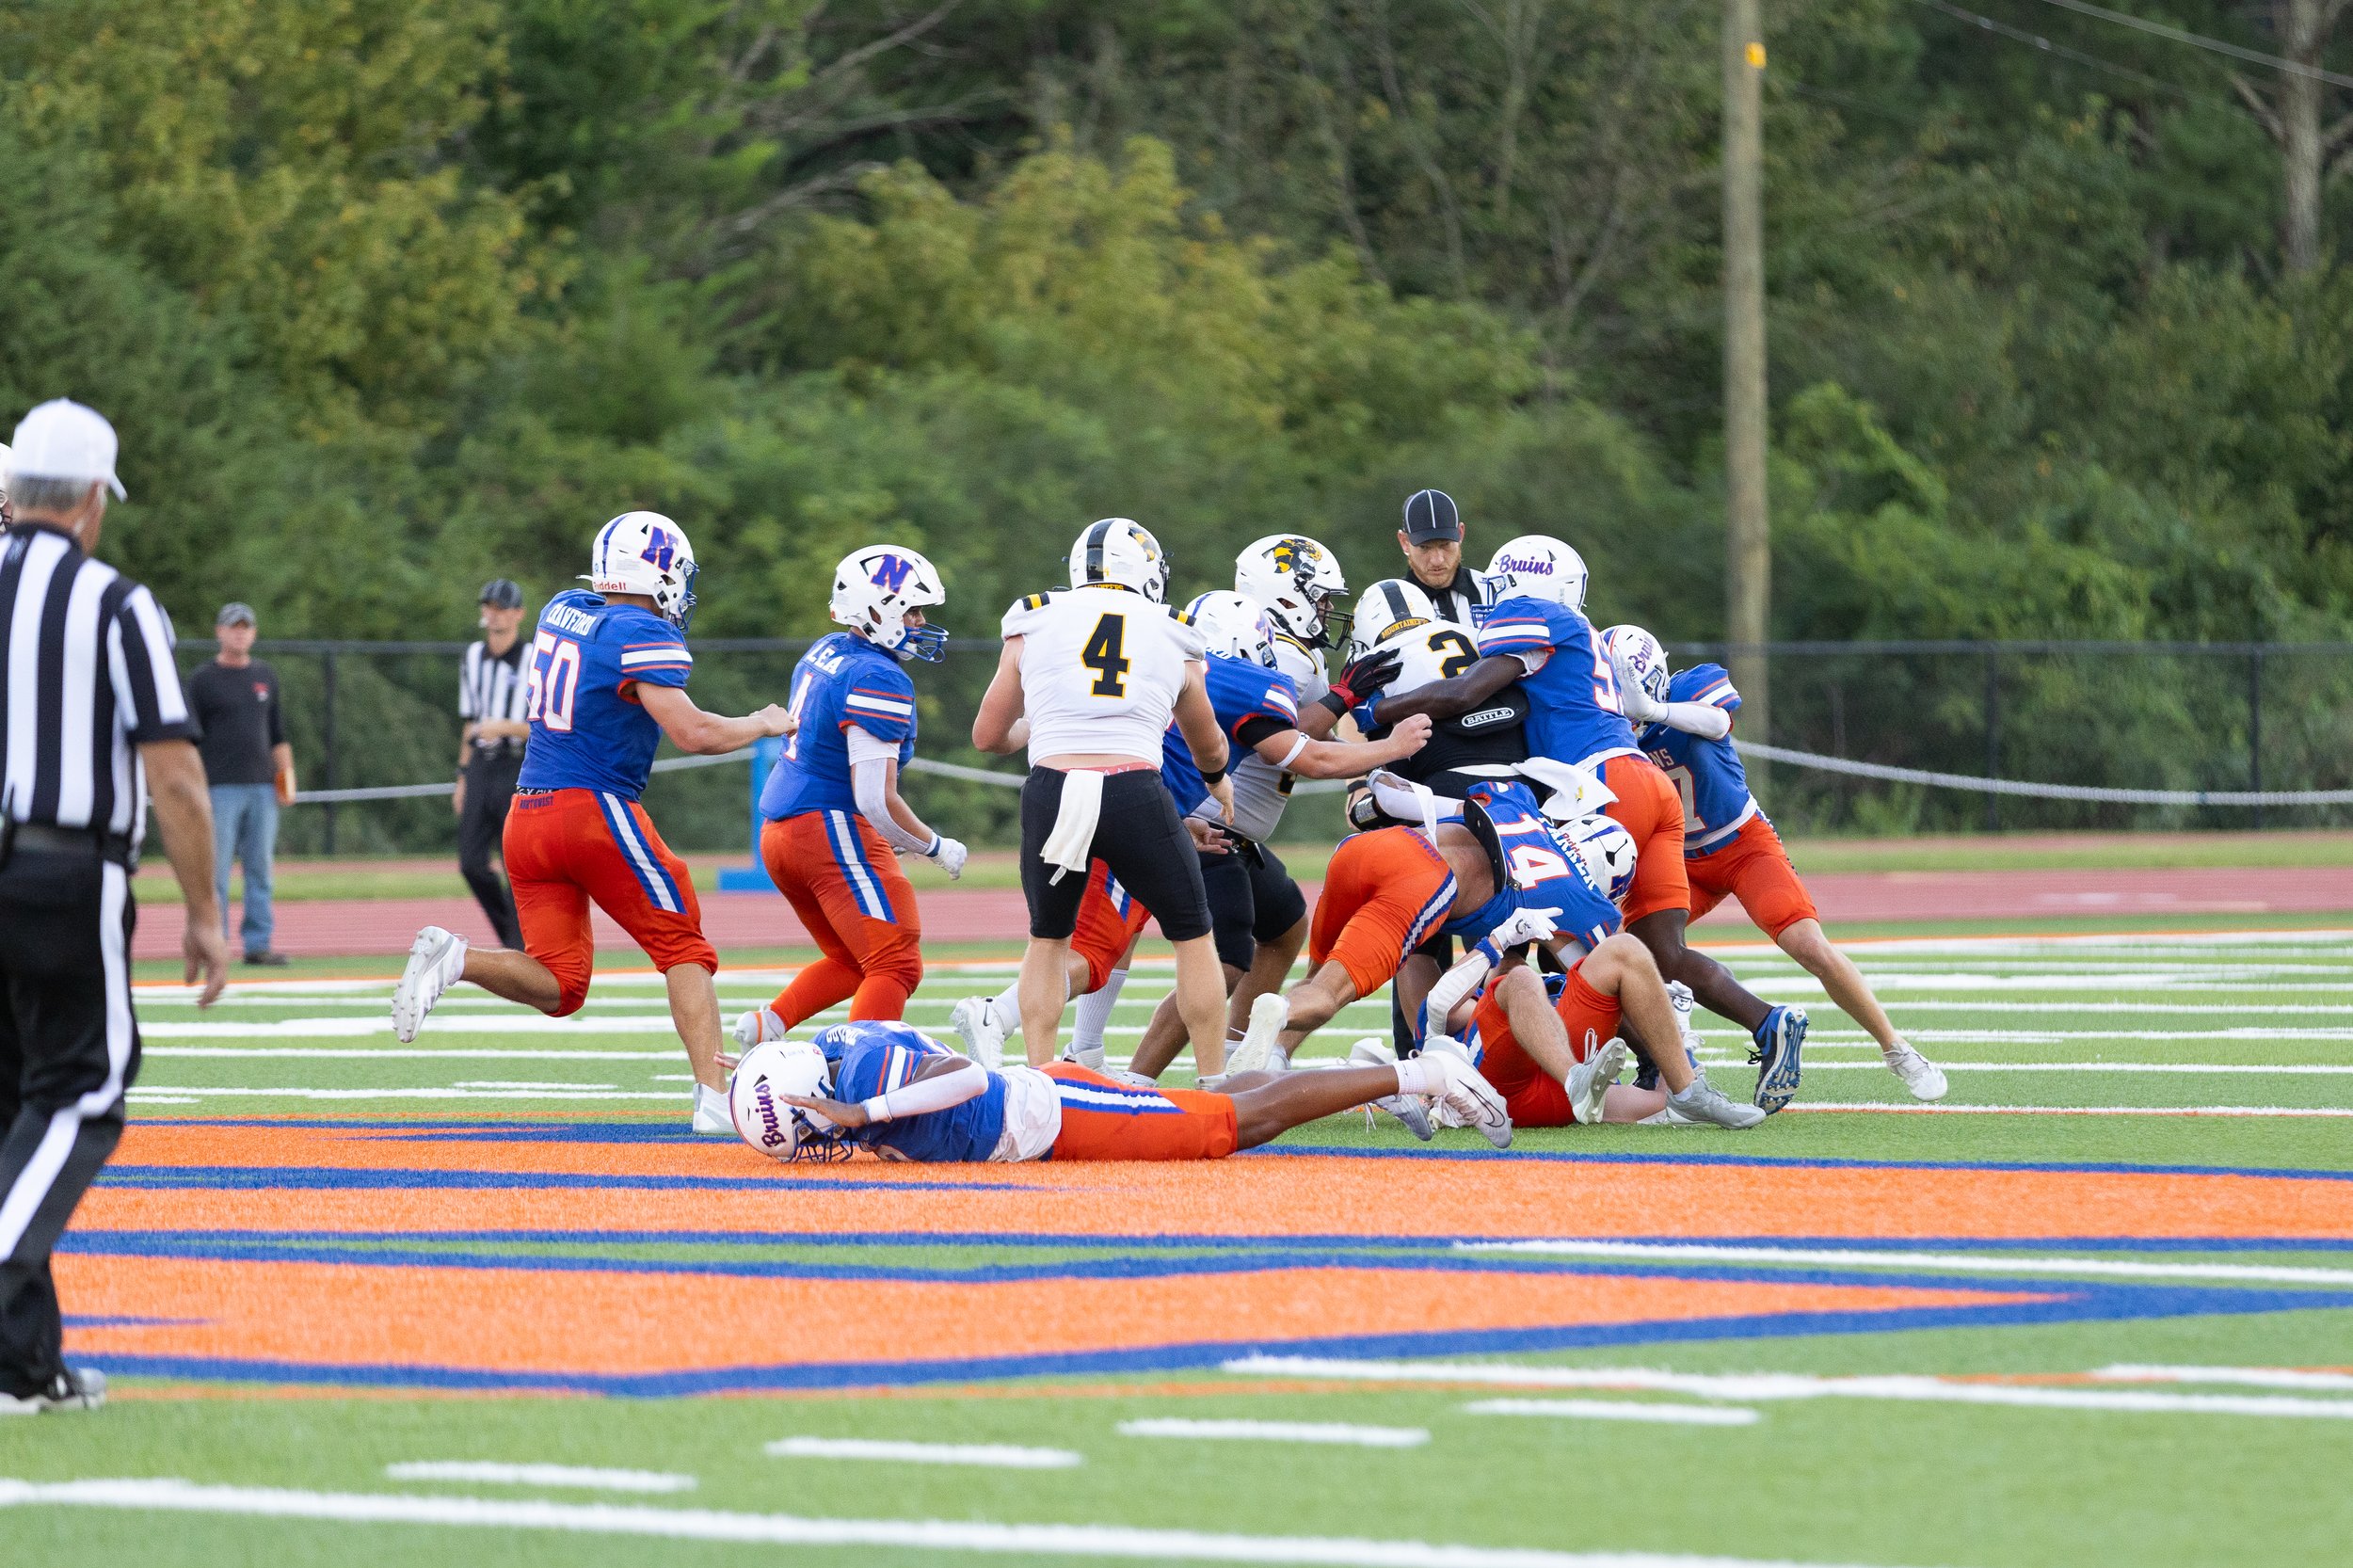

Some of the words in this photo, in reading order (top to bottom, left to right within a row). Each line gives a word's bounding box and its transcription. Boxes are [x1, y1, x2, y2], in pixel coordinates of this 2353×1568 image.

[640, 526, 679, 573] N
[871, 553, 914, 595] N
[1499, 554, 1554, 576] Bruins
[807, 643, 845, 675] LEA
[1080, 612, 1131, 698] 4
[1426, 629, 1481, 680] 2
[527, 630, 581, 732] 50
[1466, 710, 1511, 724] BATTLE
[1495, 813, 1572, 891] 14
[755, 1083, 786, 1147] Bruins
